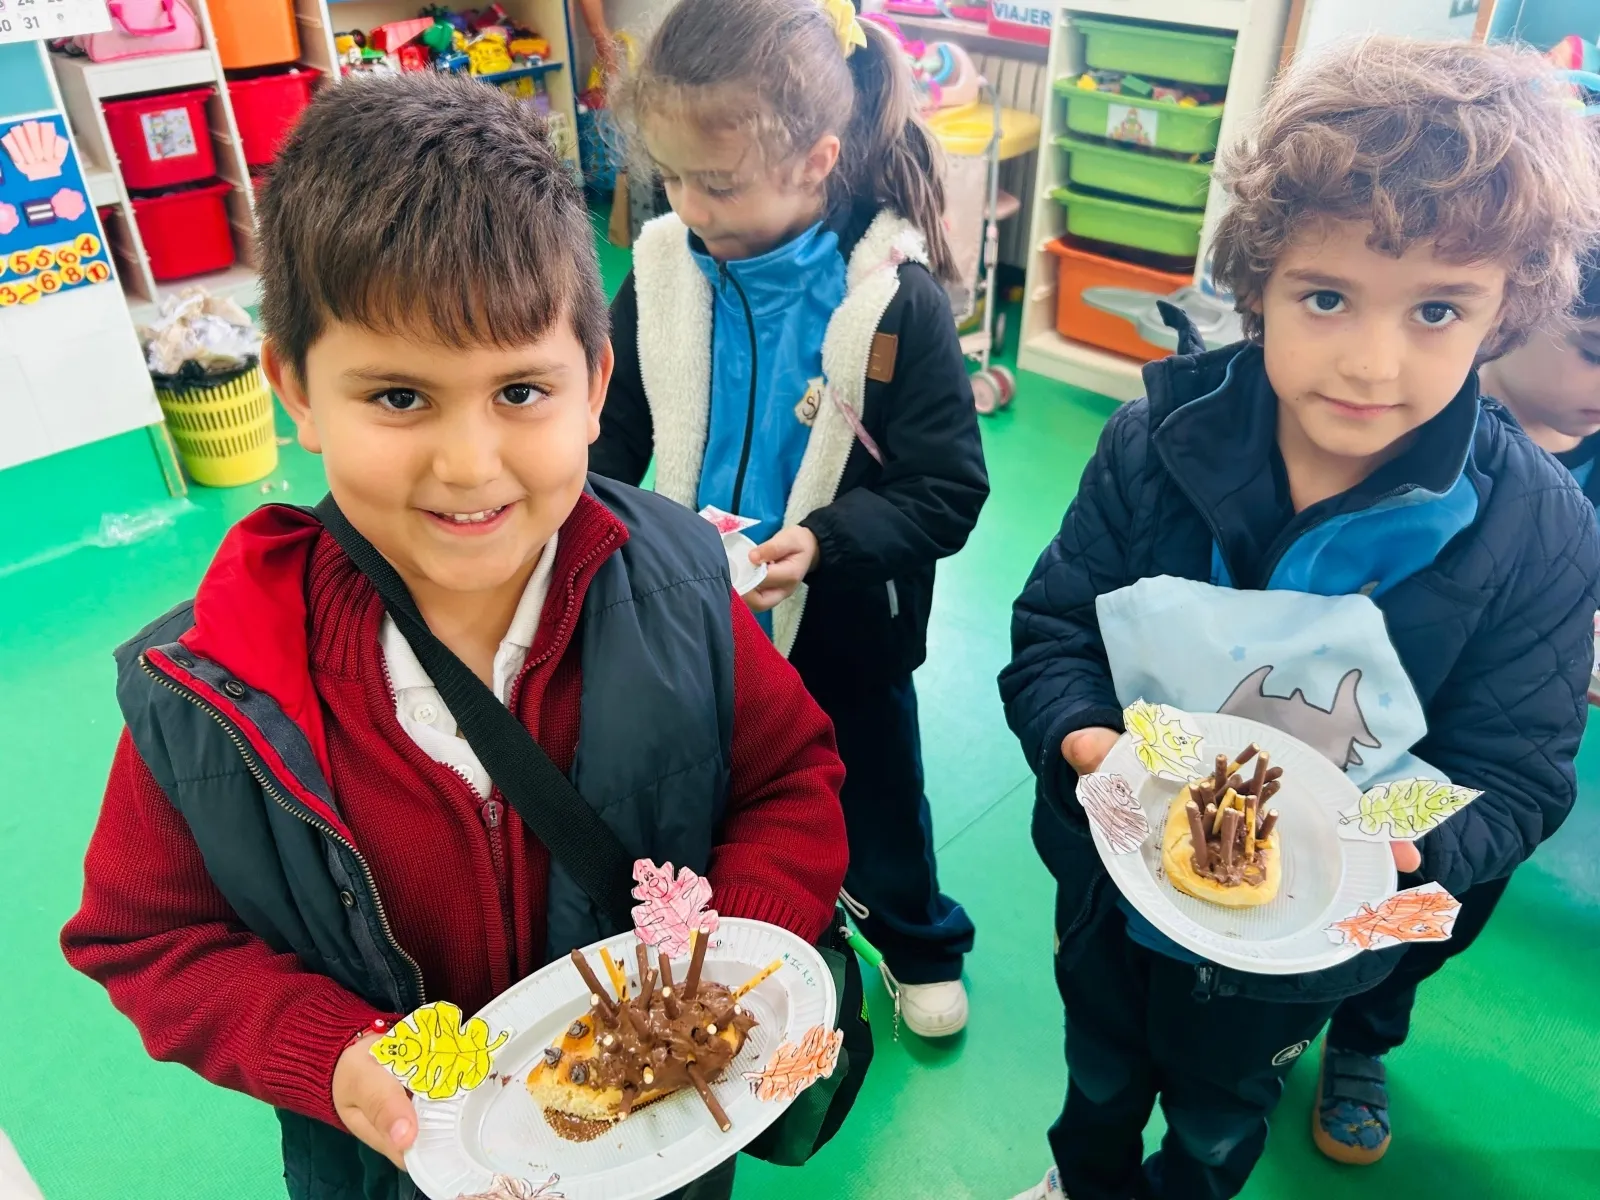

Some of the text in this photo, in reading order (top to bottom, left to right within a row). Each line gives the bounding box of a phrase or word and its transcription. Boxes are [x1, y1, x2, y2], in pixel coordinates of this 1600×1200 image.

[23, 16, 40, 29] 31
[994, 3, 1053, 27] VIAJER
[16, 254, 31, 273] 5
[36, 248, 53, 267] 5
[80, 236, 94, 255] 4
[41, 273, 56, 291] 6
[65, 267, 82, 283] 8
